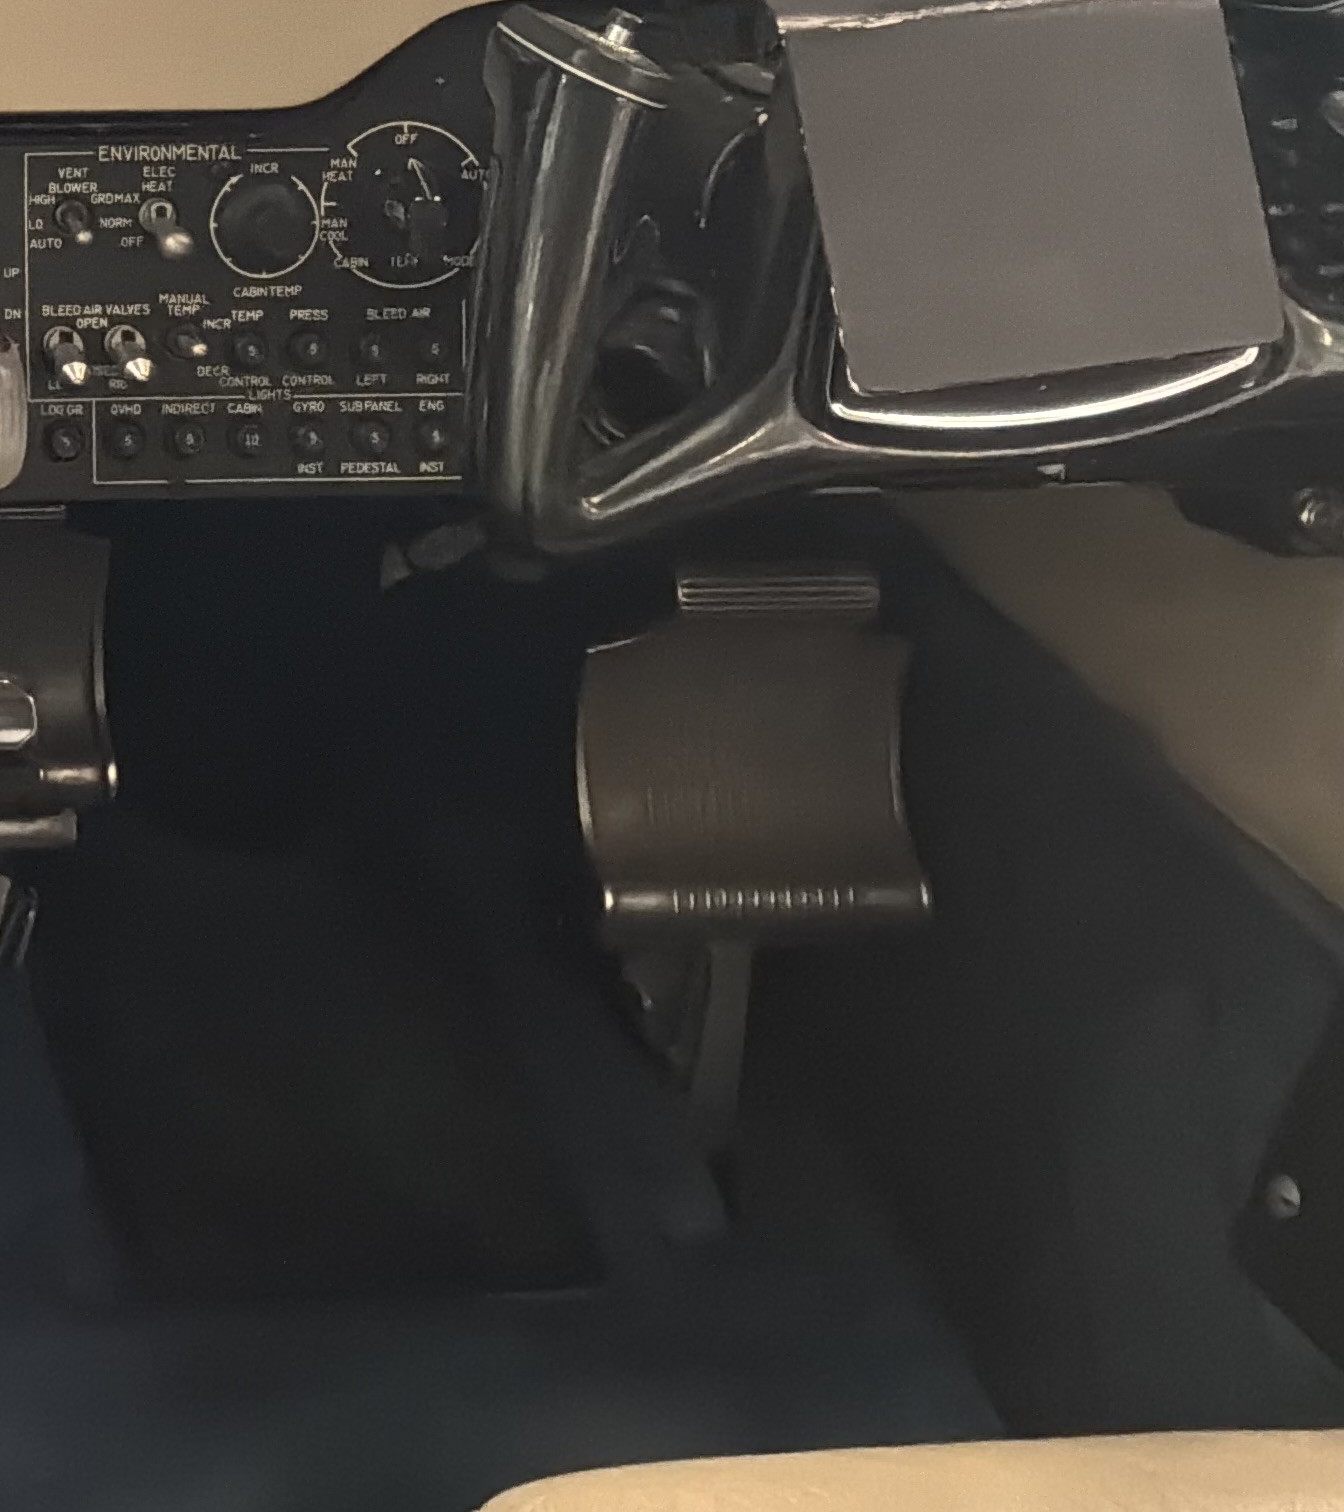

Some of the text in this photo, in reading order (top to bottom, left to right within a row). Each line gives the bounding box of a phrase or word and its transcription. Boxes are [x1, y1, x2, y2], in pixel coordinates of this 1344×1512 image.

[98, 144, 242, 162] ENVIRONMENTAL
[48, 181, 98, 194] BLOWER
[99, 218, 133, 229] NORM
[219, 375, 272, 387] CONTROL
[340, 461, 401, 474] PEDESTAL
